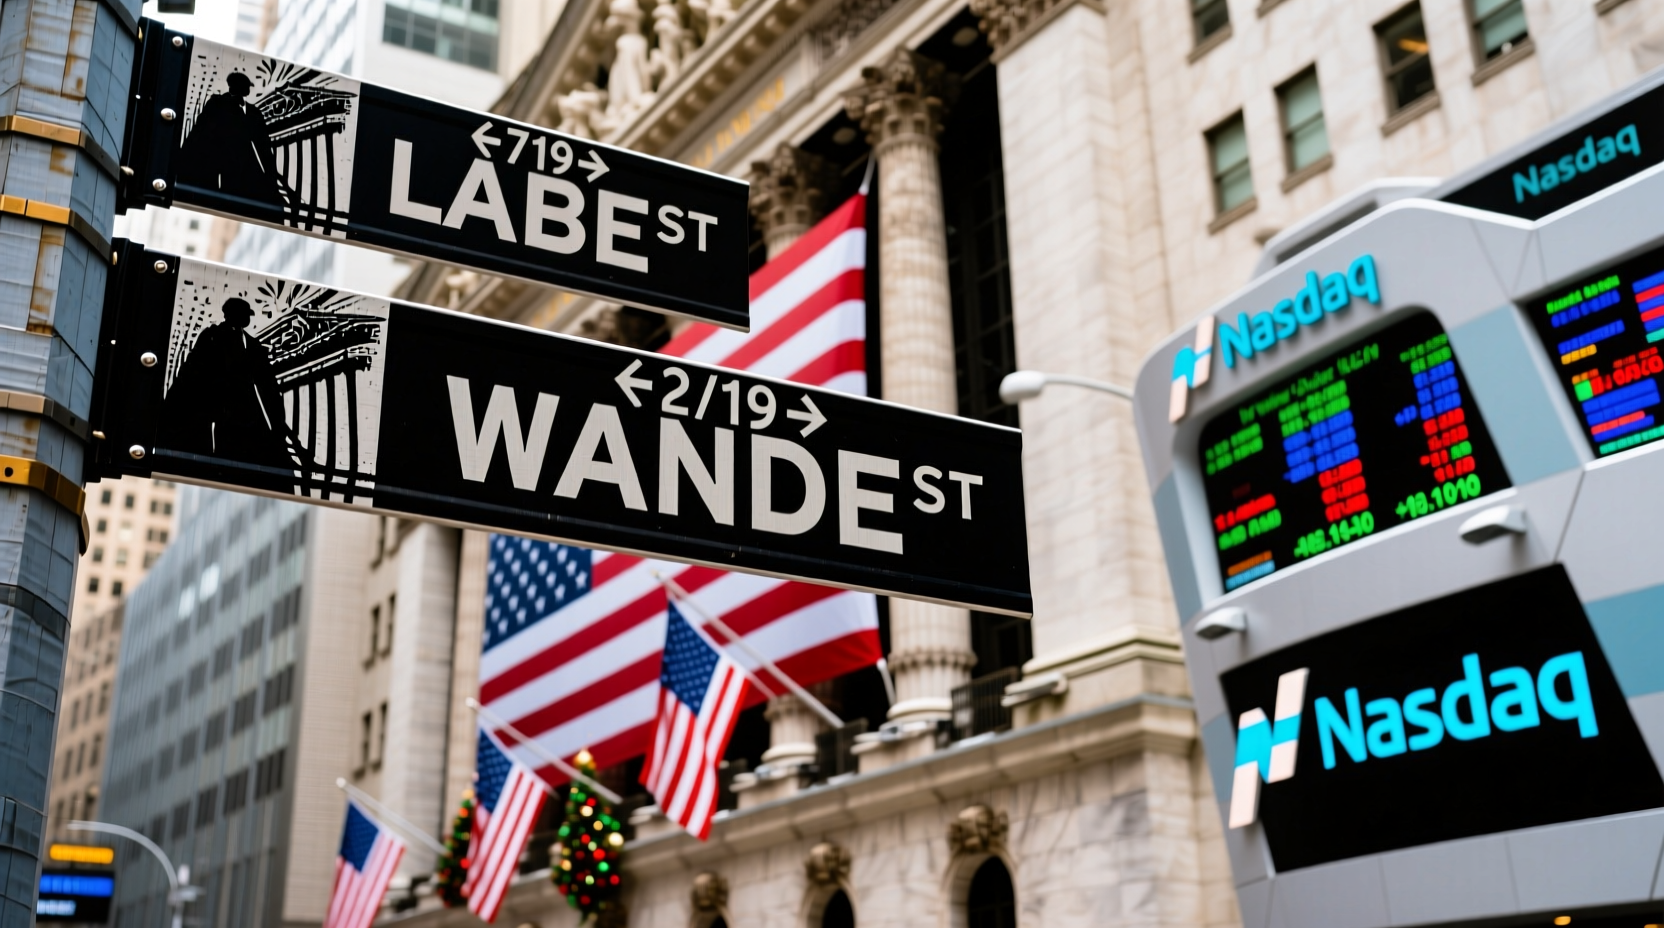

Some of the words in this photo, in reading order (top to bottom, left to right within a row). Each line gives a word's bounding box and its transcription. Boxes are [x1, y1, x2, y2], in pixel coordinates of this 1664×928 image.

[390, 139, 649, 273] LABE
[657, 205, 718, 251] ST
[508, 127, 573, 174] 719
[1513, 124, 1641, 203] Nasdaq
[1218, 254, 1381, 368] Nasdaq
[662, 367, 777, 430] 2/19
[447, 375, 904, 555] WANDE
[914, 466, 983, 520] ST
[1315, 651, 1598, 769] Nasdaq
